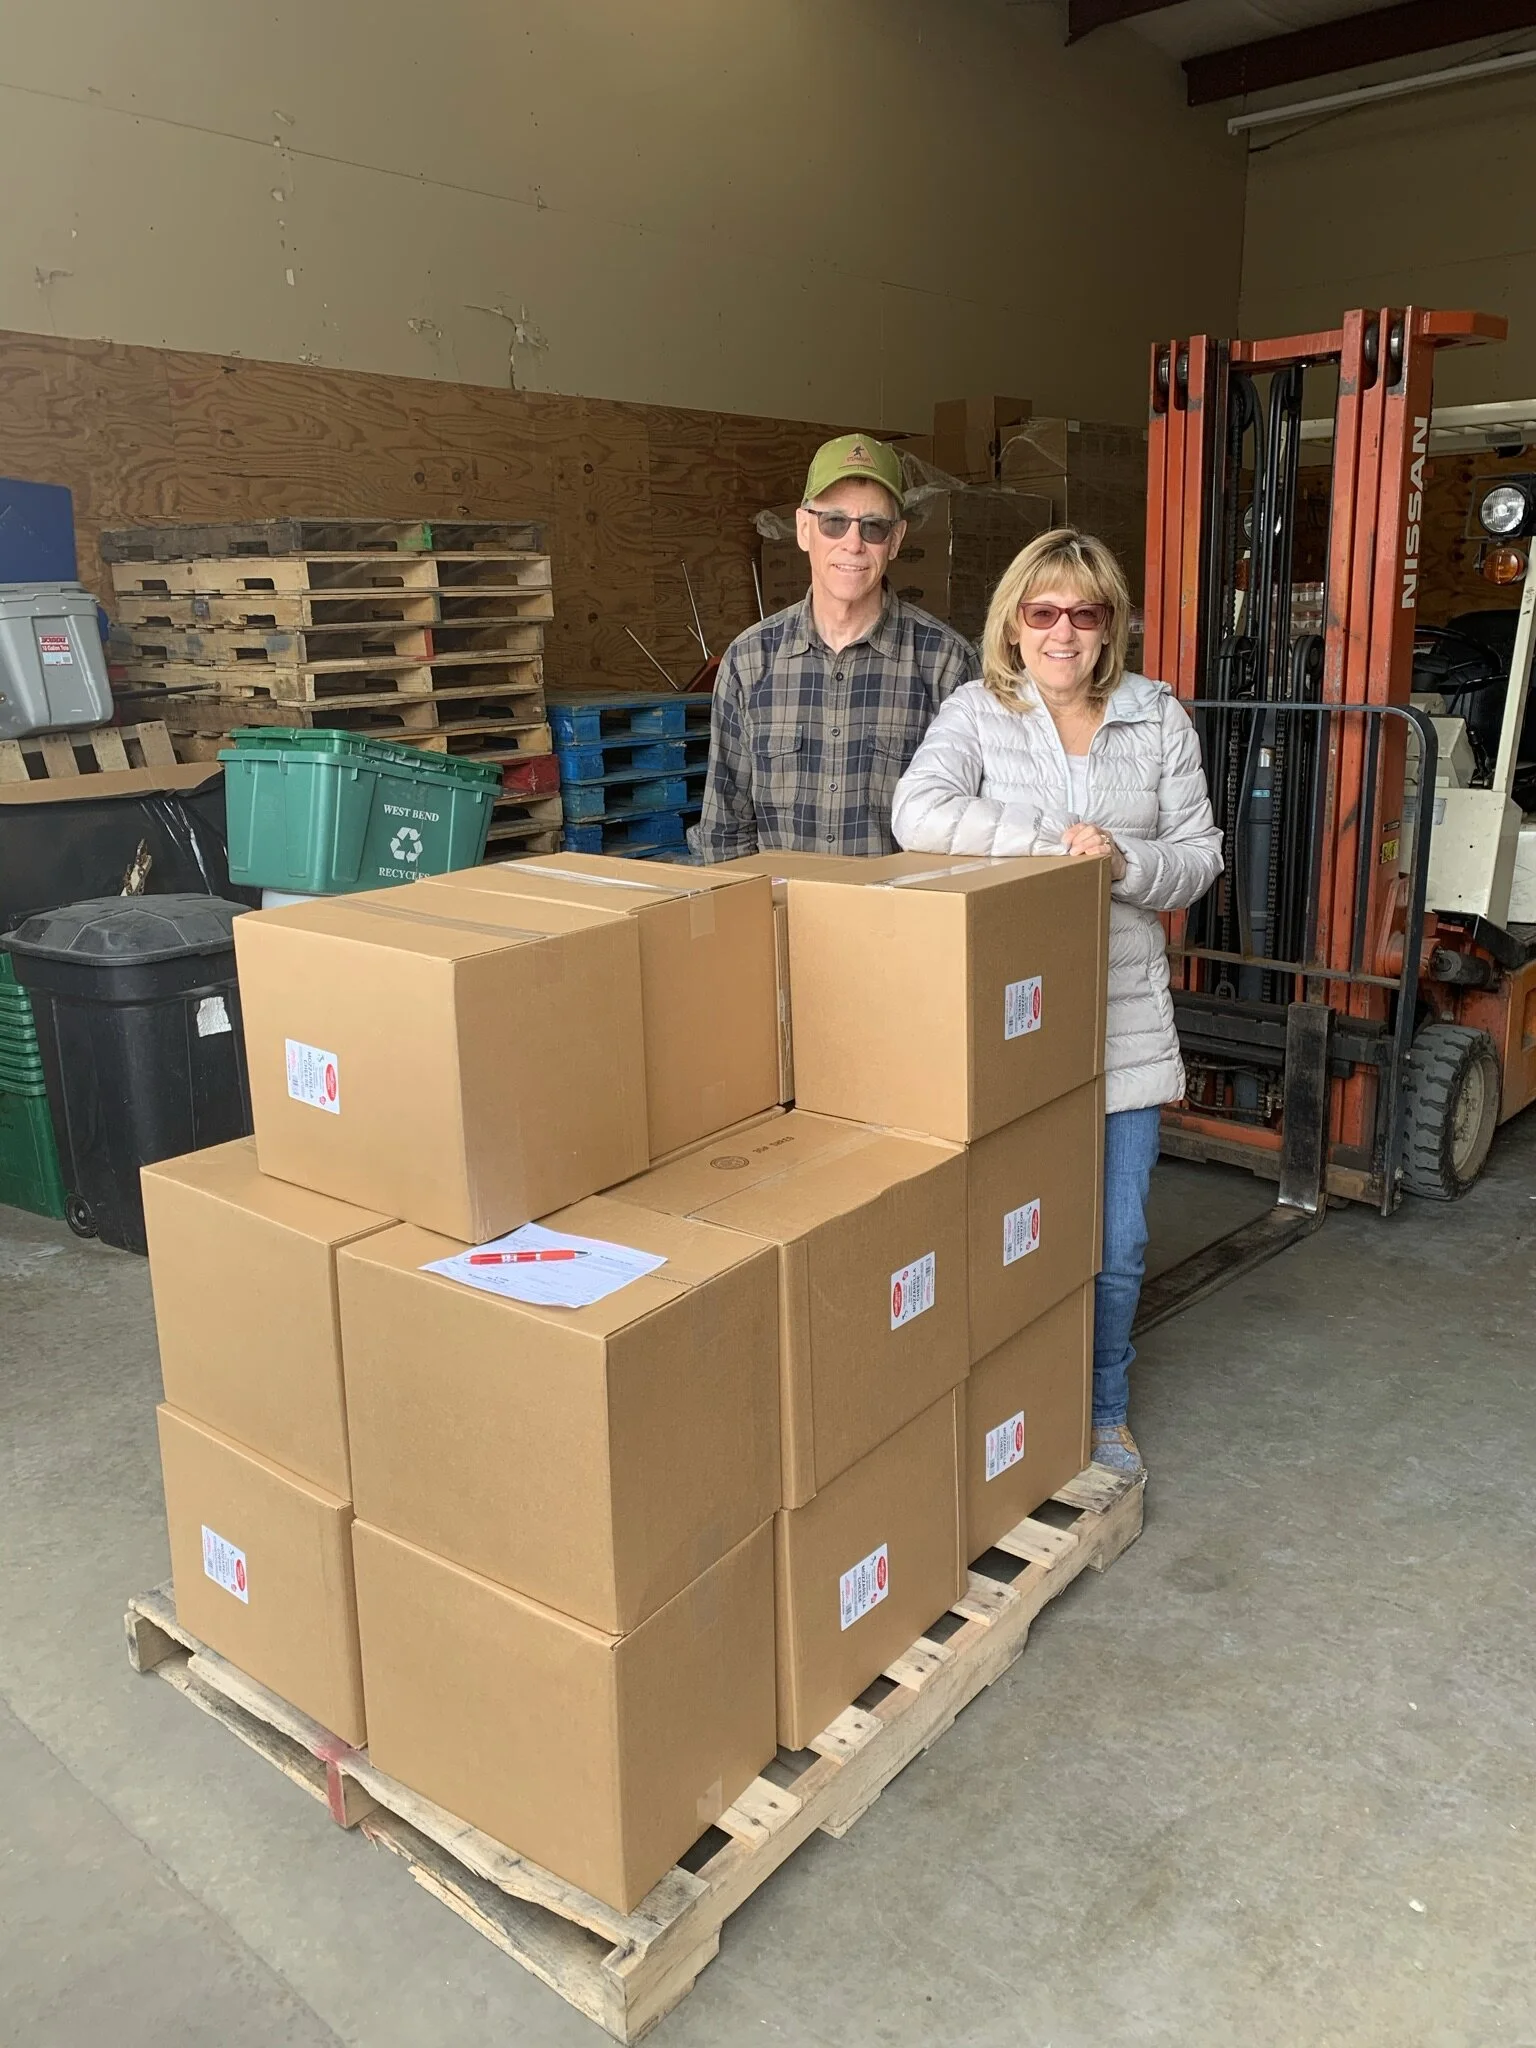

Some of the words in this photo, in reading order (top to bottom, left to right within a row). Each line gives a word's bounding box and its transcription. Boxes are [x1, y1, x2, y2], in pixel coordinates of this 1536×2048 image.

[1401, 416, 1428, 609] NISSAN
[383, 804, 411, 817] WEST
[412, 809, 440, 822] BEND
